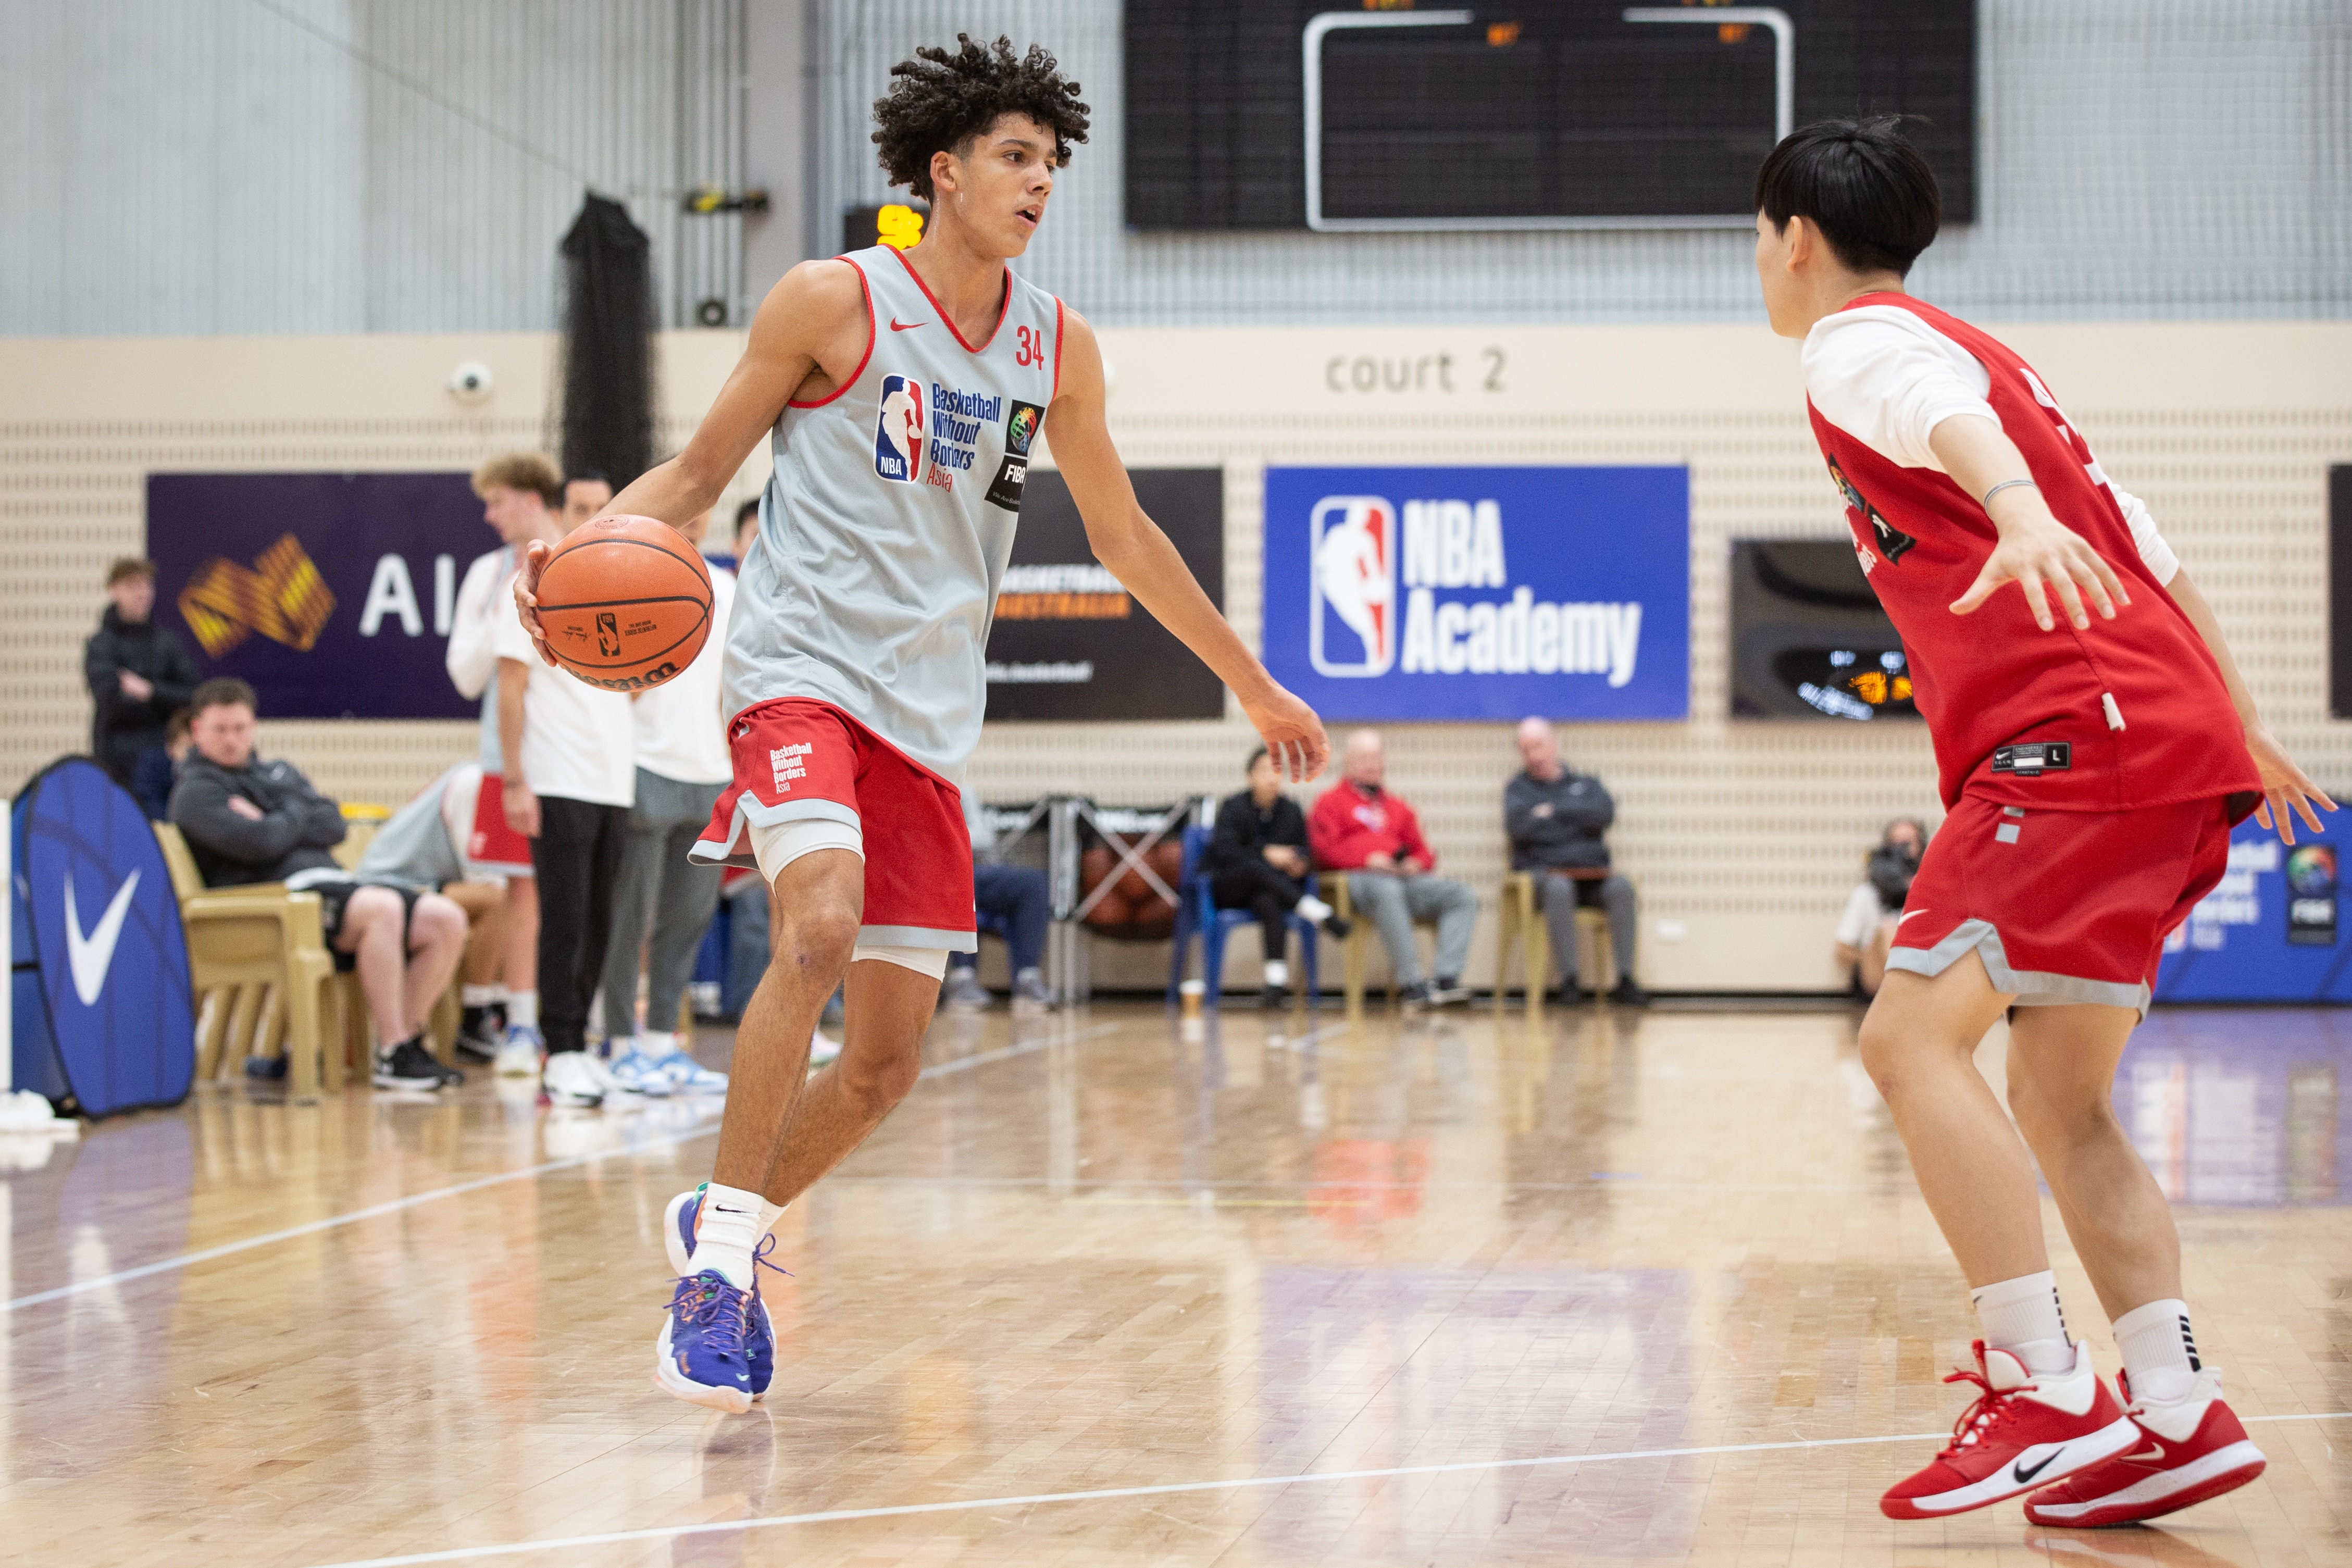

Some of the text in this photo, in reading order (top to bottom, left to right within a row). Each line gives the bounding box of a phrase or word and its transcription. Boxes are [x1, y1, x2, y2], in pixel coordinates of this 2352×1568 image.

[1016, 325, 1043, 370] 34
[1325, 346, 1507, 392] court 2
[932, 383, 1001, 422] Basketball
[933, 411, 981, 445] Without
[880, 456, 902, 476] NBA
[926, 462, 953, 493] Asia
[1004, 464, 1026, 483] FIBA
[1402, 498, 1506, 588] NBA
[359, 553, 456, 637] AI
[1400, 586, 1642, 688] Academy
[770, 742, 813, 762] Basketball
[771, 755, 803, 773] Without
[2052, 749, 2061, 762] L
[773, 767, 806, 783] Borders
[776, 781, 791, 794] Asia
